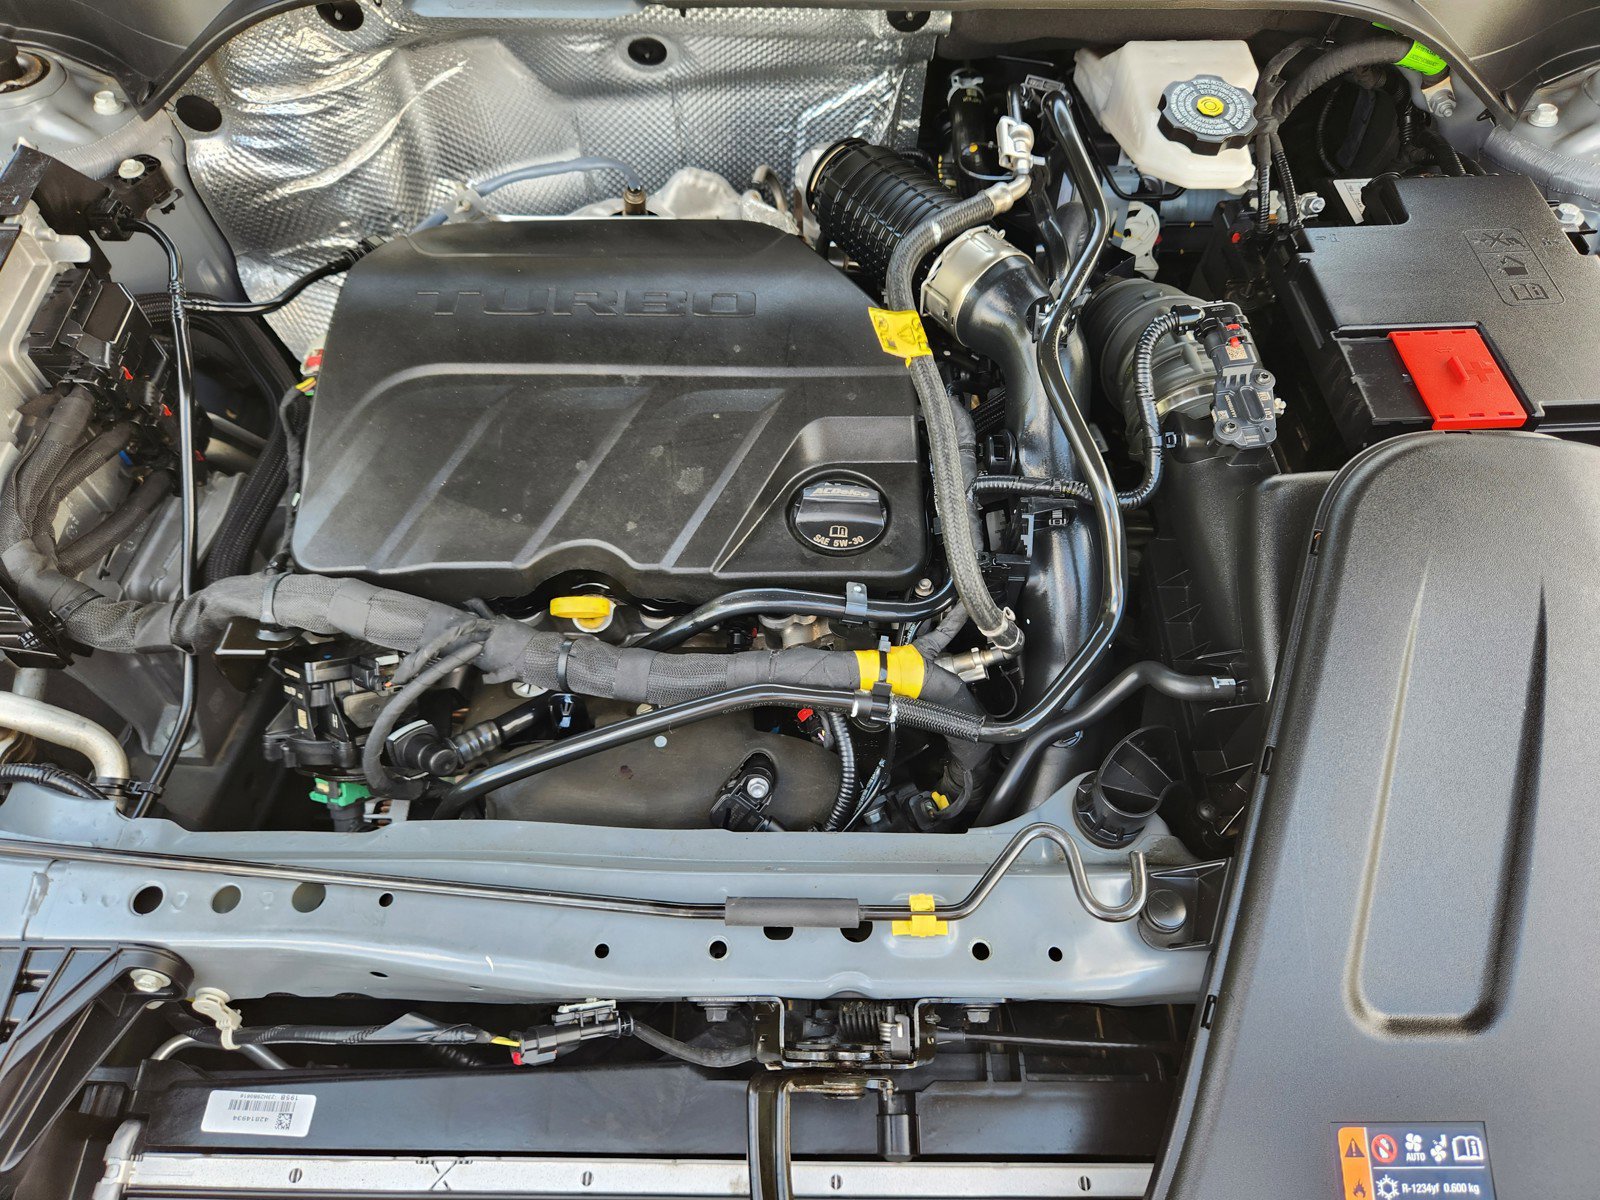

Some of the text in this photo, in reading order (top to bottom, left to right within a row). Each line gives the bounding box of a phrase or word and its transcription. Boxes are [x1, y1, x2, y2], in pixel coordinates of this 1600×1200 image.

[416, 288, 757, 318] TURBO
[811, 487, 870, 498] ACDelco
[813, 534, 864, 547] SAE 5W-30
[1406, 1152, 1426, 1162] AUTO
[1401, 1182, 1480, 1195] R-1234yf 0.600 kg
